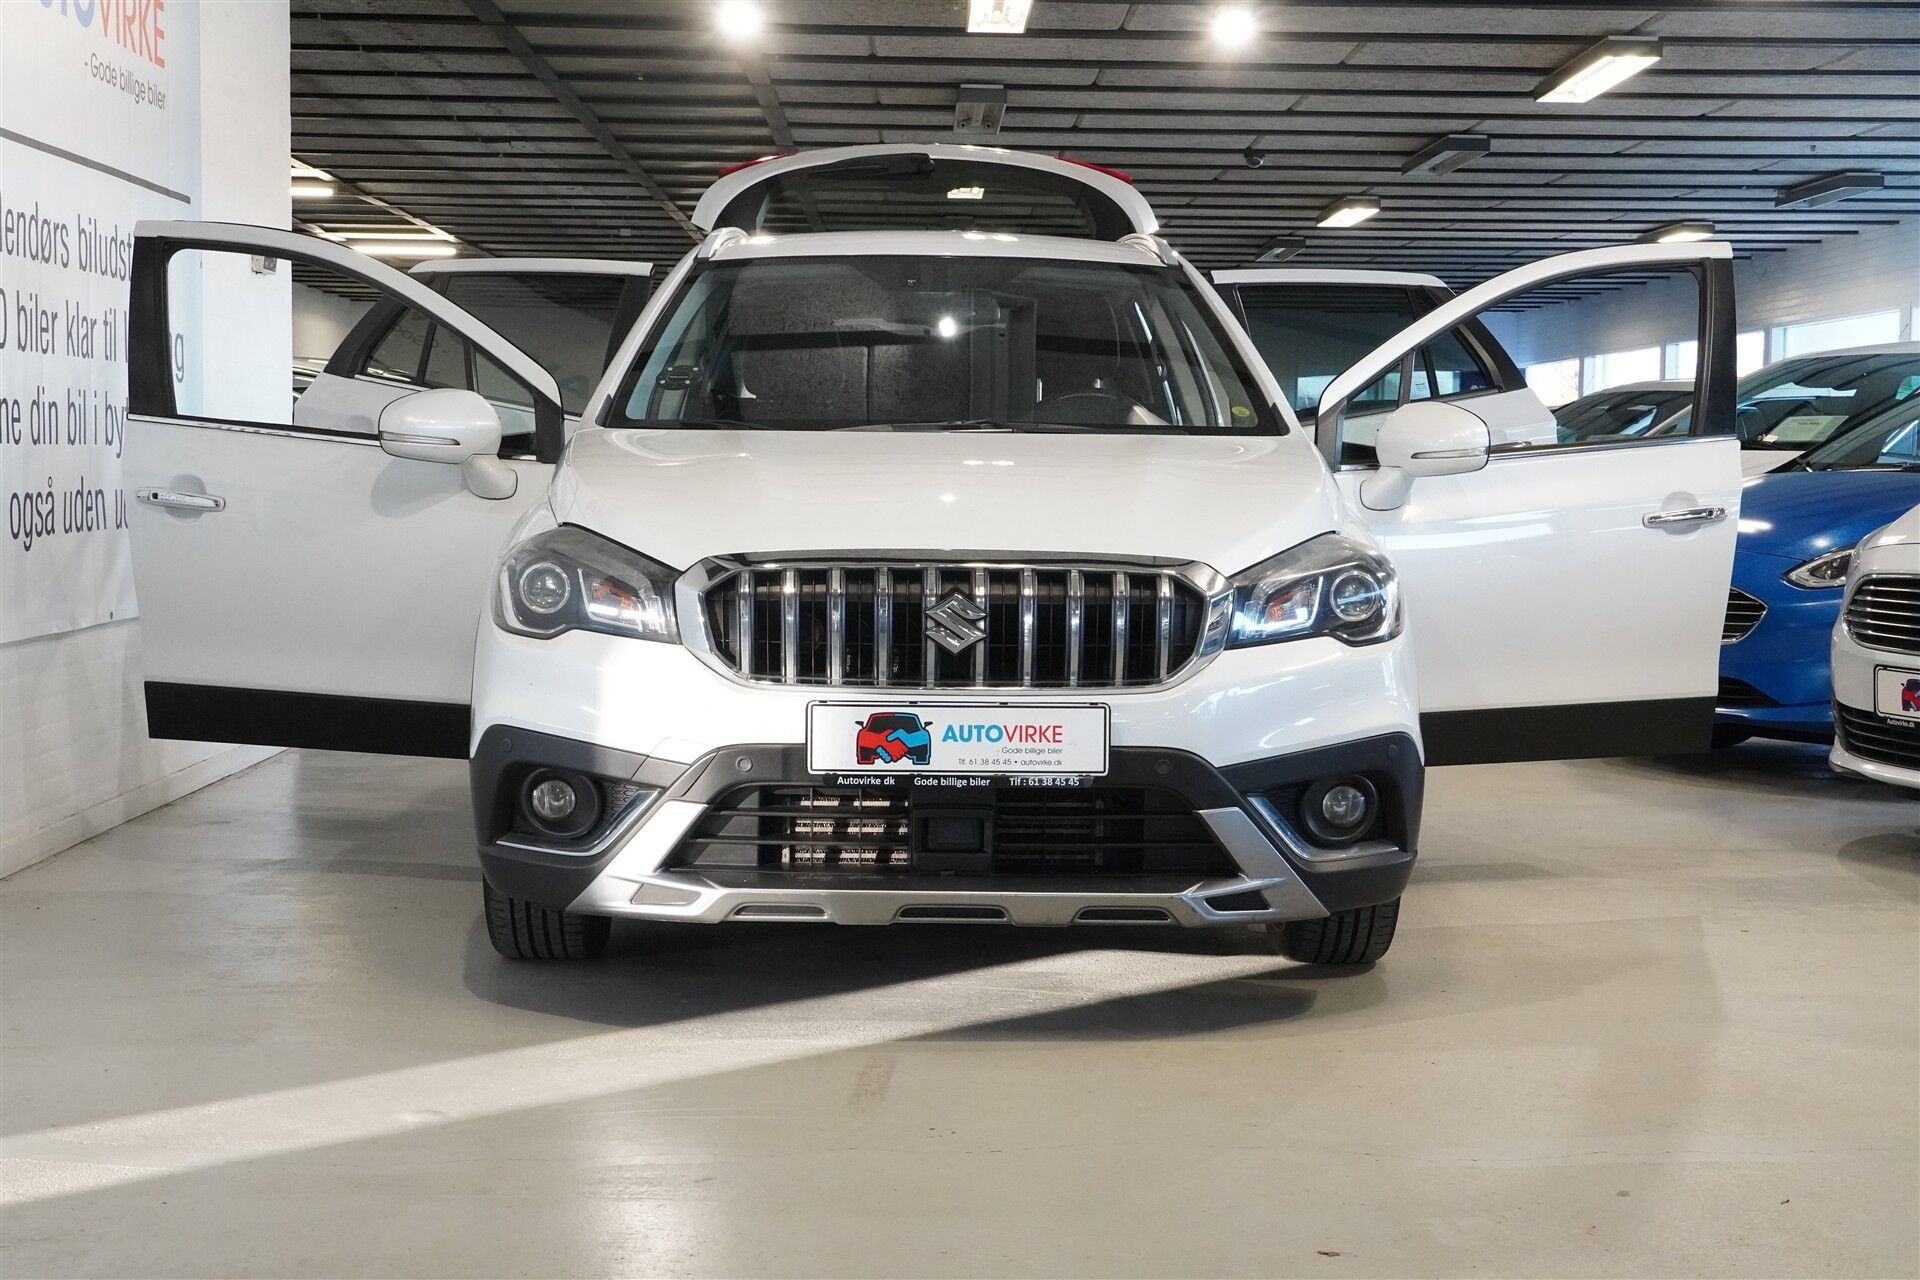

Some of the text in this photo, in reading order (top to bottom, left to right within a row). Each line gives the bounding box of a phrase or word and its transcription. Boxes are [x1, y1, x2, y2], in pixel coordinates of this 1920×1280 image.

[90, 52, 117, 87] Gode
[119, 66, 146, 104] billige
[148, 81, 166, 110] biler
[0, 190, 69, 268] endørs
[16, 290, 58, 354] biler
[66, 299, 97, 359] klar
[103, 307, 117, 362] til
[30, 385, 59, 445] din
[67, 387, 86, 446] bil
[94, 390, 98, 445] i
[9, 476, 56, 552] også
[63, 475, 107, 534] uden
[942, 724, 1063, 743] AUTOVIRKE
[1001, 746, 1023, 754] Gode
[1024, 746, 1046, 755] billige
[1047, 746, 1063, 754] biler
[1020, 757, 1063, 766] autovirke.dk
[837, 776, 881, 785] Autovirke
[884, 776, 896, 785] dk
[914, 777, 938, 786] Gode
[940, 777, 968, 788] billige
[969, 777, 991, 786] biler
[1028, 777, 1040, 786] 61
[1042, 777, 1053, 786] 38
[1054, 777, 1066, 786] 45
[1068, 777, 1080, 786] 45
